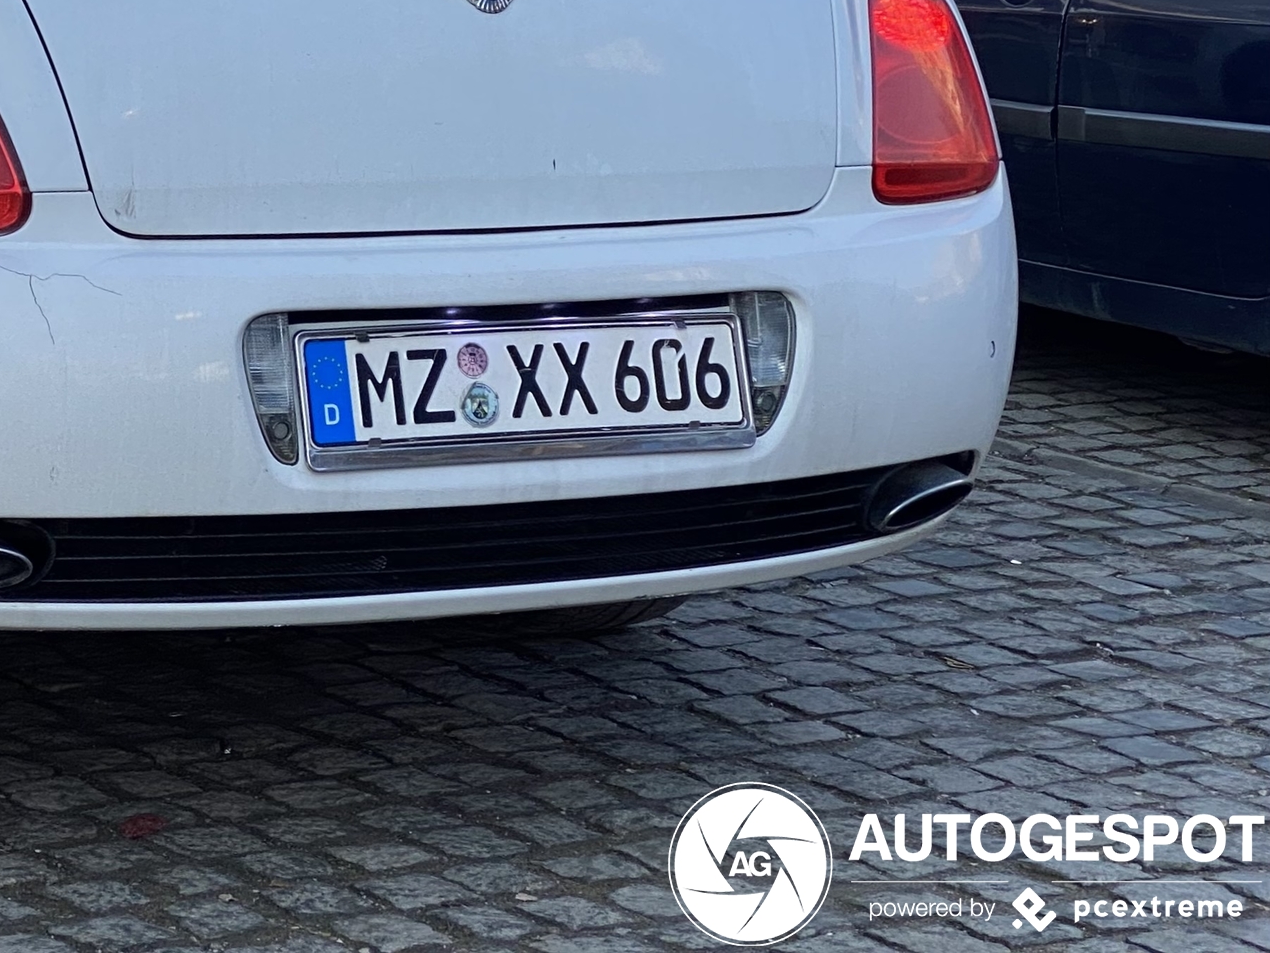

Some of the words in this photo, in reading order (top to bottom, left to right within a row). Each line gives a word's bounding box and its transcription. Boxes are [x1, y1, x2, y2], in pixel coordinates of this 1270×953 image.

[324, 402, 340, 426] D
[355, 348, 457, 428] MZ
[506, 341, 599, 419] XX
[614, 336, 731, 413] 606
